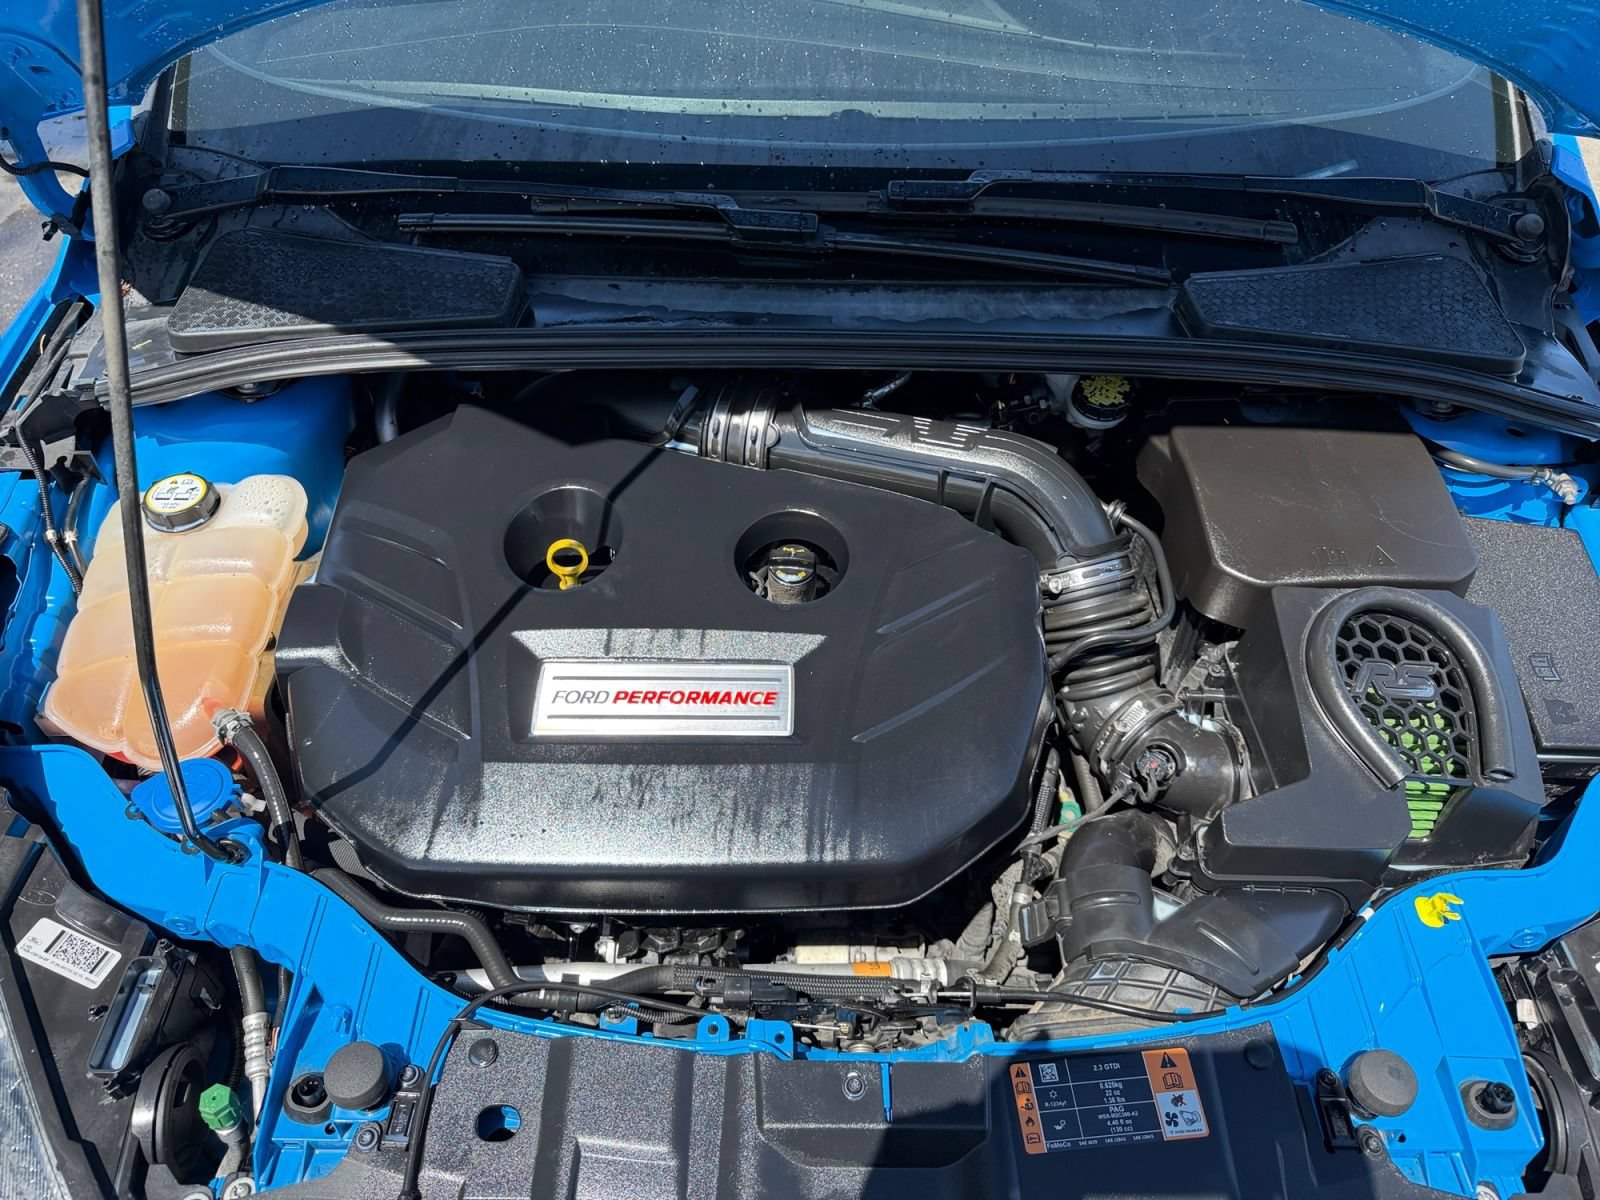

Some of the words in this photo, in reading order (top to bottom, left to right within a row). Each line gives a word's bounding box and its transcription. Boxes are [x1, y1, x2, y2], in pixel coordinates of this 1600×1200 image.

[1350, 658, 1440, 702] RS
[552, 690, 610, 704] FORD
[613, 690, 779, 706] PERFORMANCE
[1109, 1105, 1125, 1113] PAG
[1046, 1141, 1072, 1149] FoMoCo
